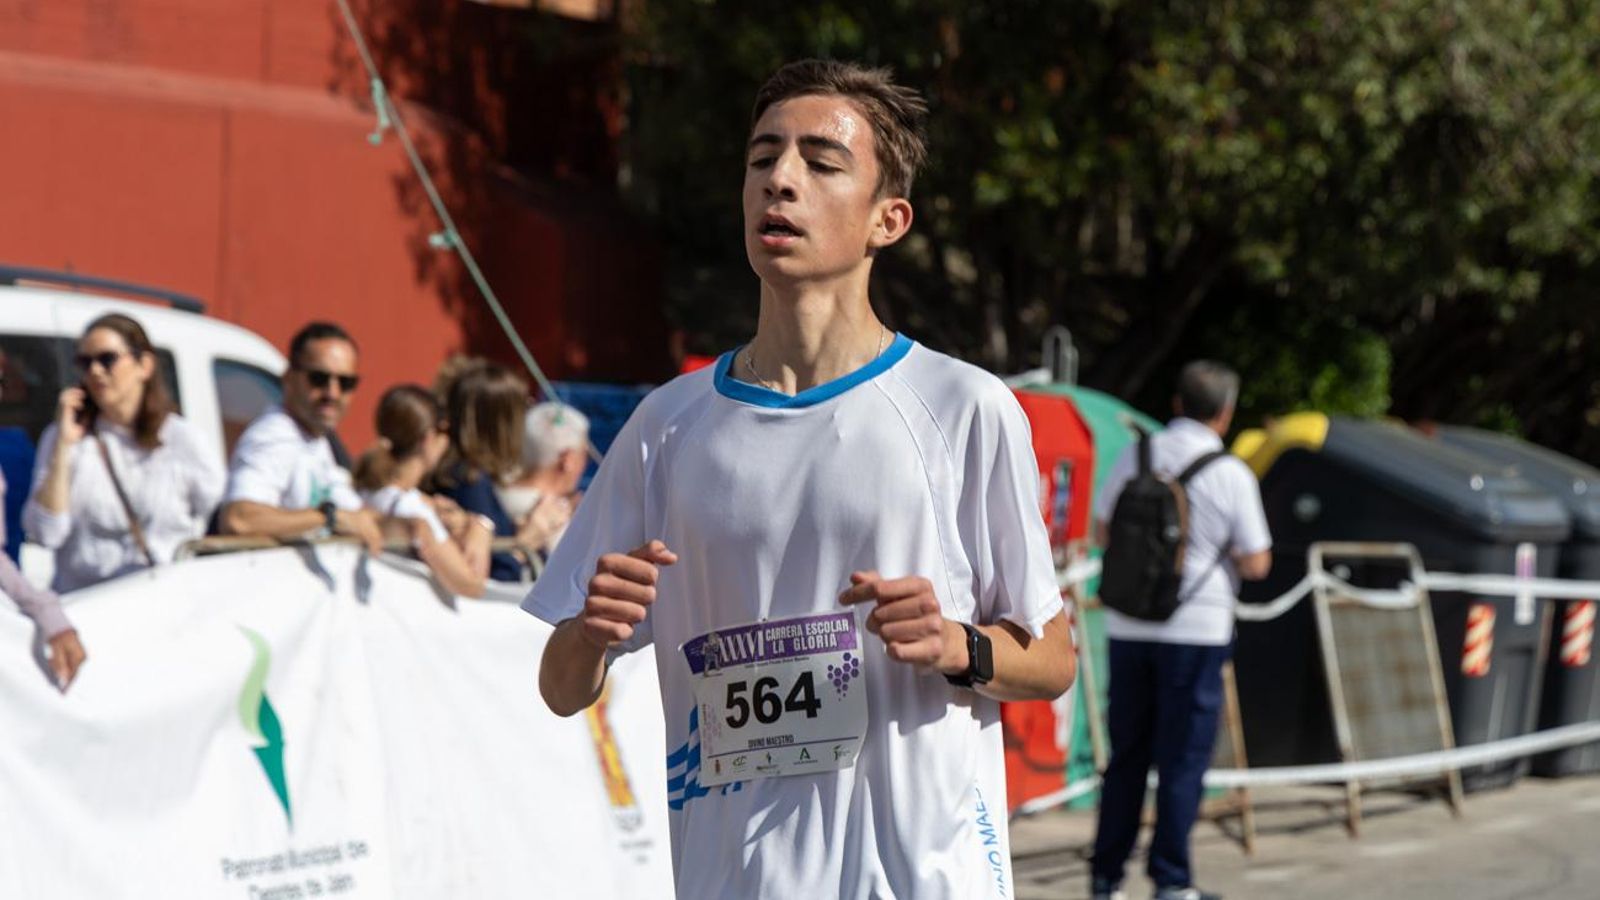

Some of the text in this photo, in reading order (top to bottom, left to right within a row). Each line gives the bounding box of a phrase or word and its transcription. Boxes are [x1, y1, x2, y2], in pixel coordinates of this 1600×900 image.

[766, 619, 849, 642] CARRERA ESCOLAR
[773, 633, 838, 654] LA GLORIA
[726, 671, 821, 729] 564
[766, 734, 795, 745] MAESTRO
